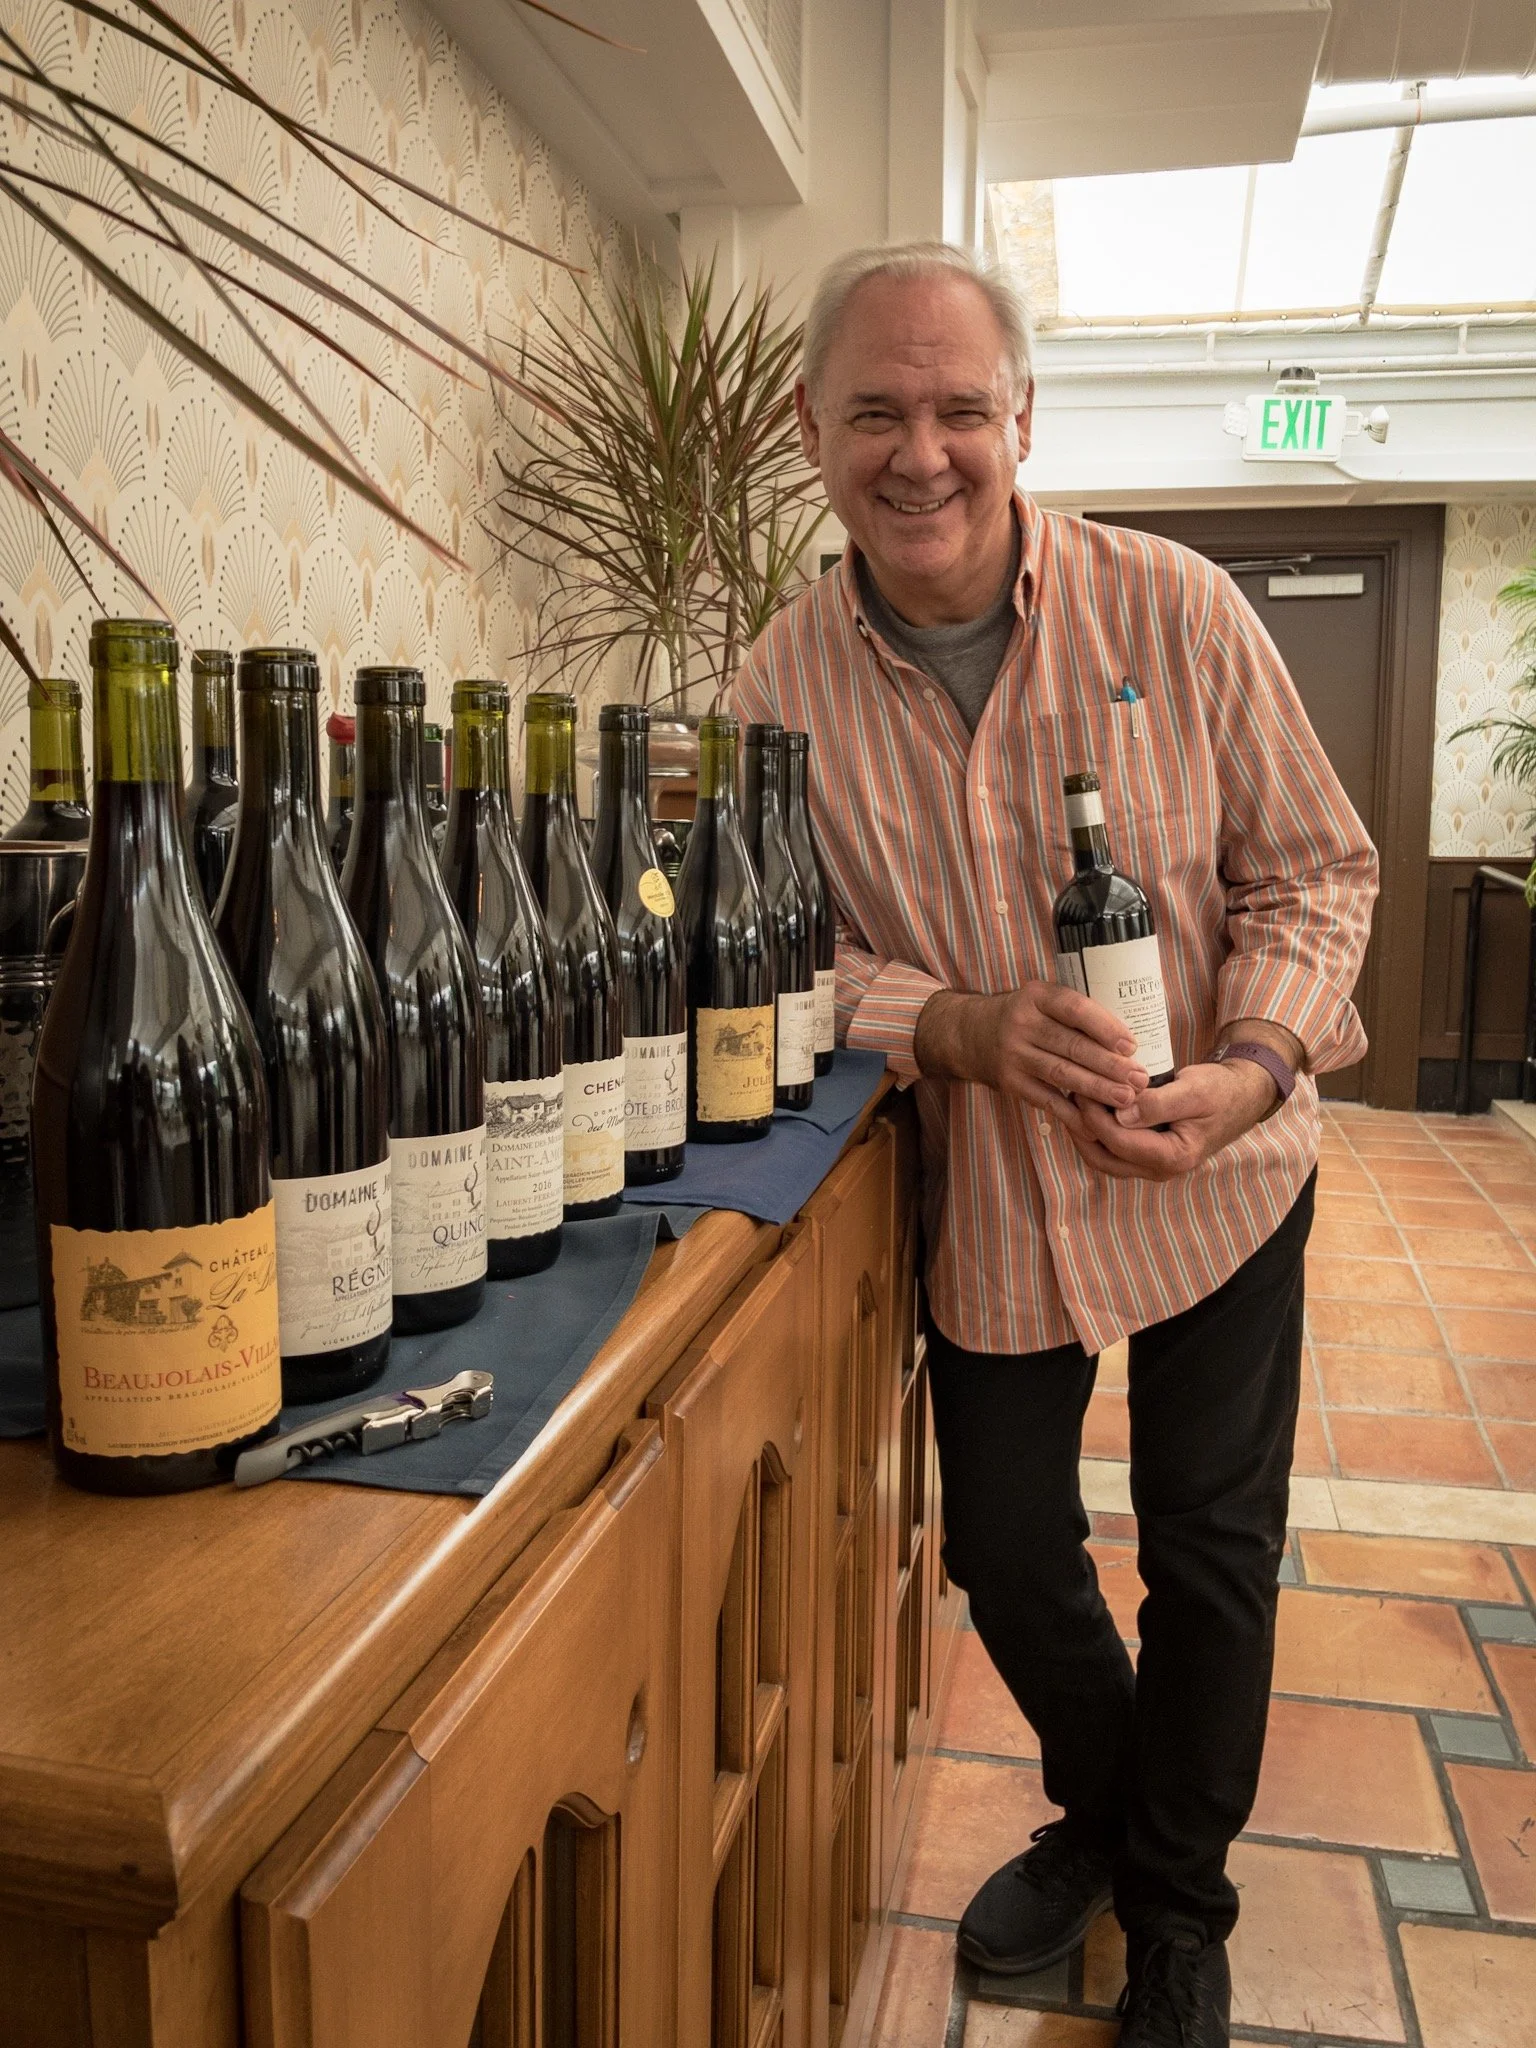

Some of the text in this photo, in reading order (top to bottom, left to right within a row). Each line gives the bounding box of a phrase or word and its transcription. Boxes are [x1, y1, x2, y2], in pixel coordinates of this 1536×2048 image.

[1261, 400, 1332, 449] EXIT
[1118, 979, 1161, 998] LURTO
[624, 1099, 648, 1116] ÔTE
[408, 1143, 473, 1169] DOMAINE
[492, 1142, 534, 1153] DOMAINE
[532, 1178, 552, 1193] 2016
[306, 1181, 377, 1213] DOMAINE
[209, 1243, 269, 1274] CHÂTEAU
[85, 1394, 161, 1403] APPELLATION
